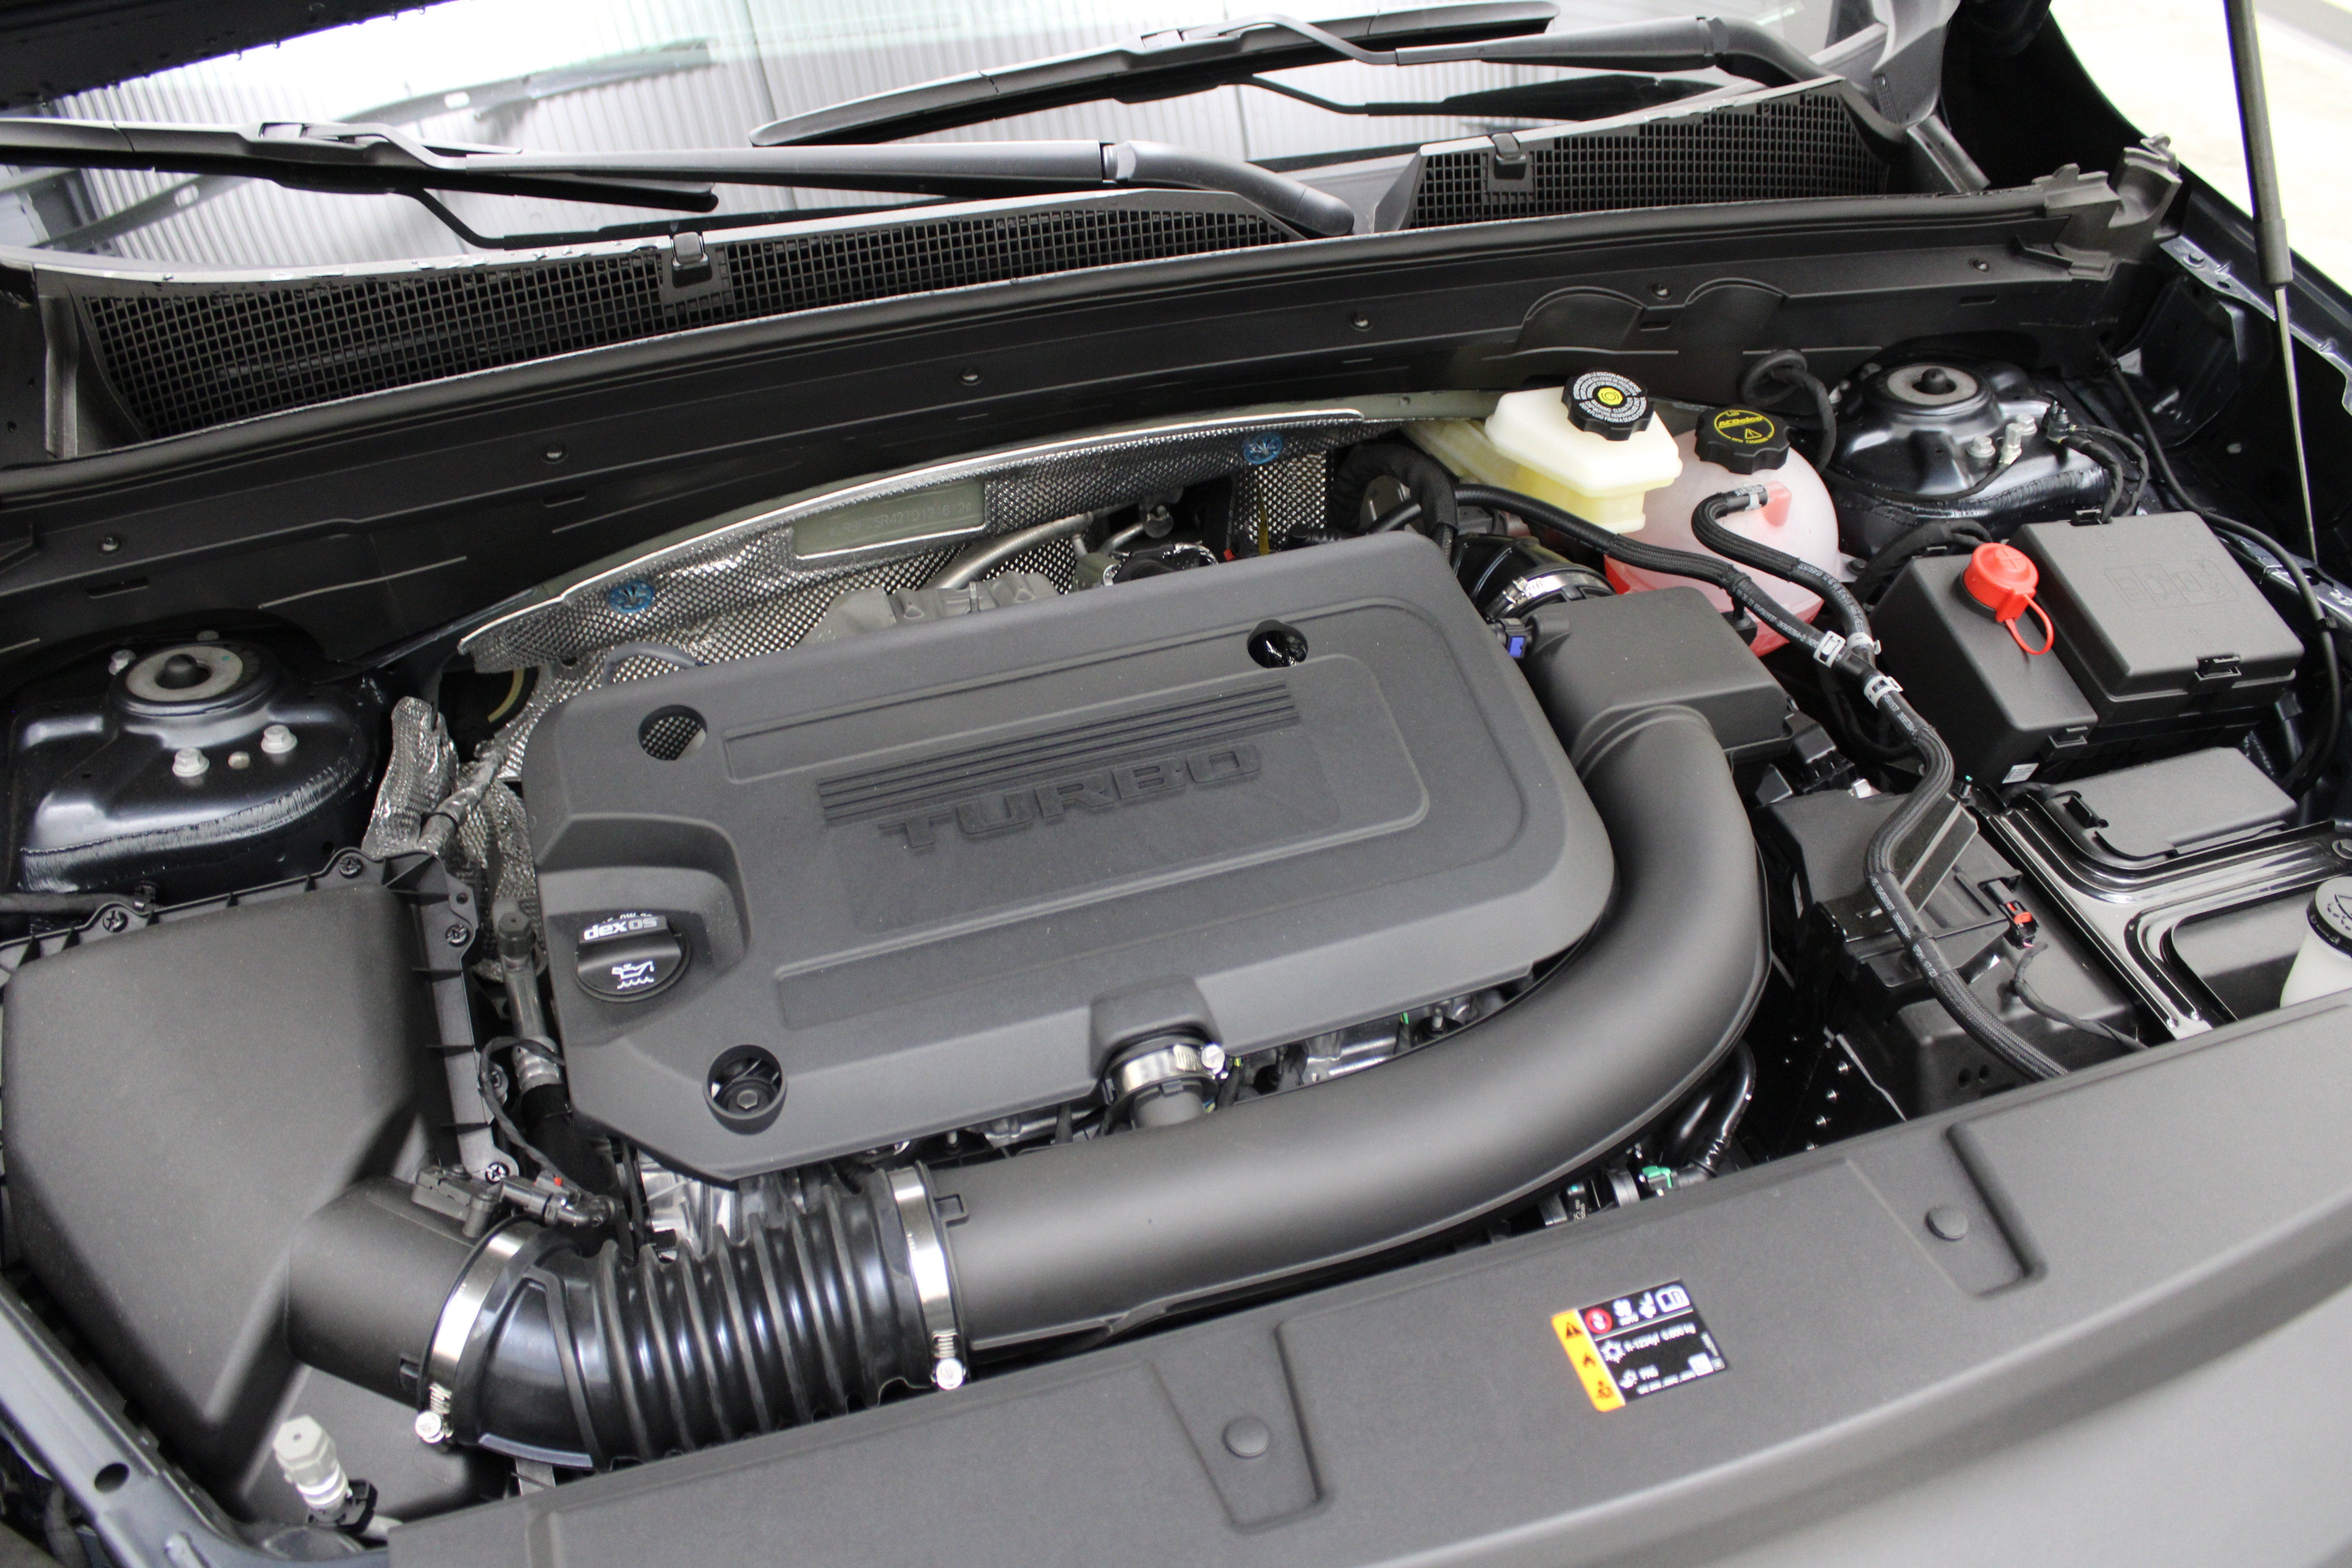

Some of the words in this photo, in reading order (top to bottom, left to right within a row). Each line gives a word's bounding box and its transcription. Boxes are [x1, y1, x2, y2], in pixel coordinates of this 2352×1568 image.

[1718, 416, 1764, 427] ACDelco
[878, 742, 1261, 850] TURBO
[584, 917, 658, 940] dexos
